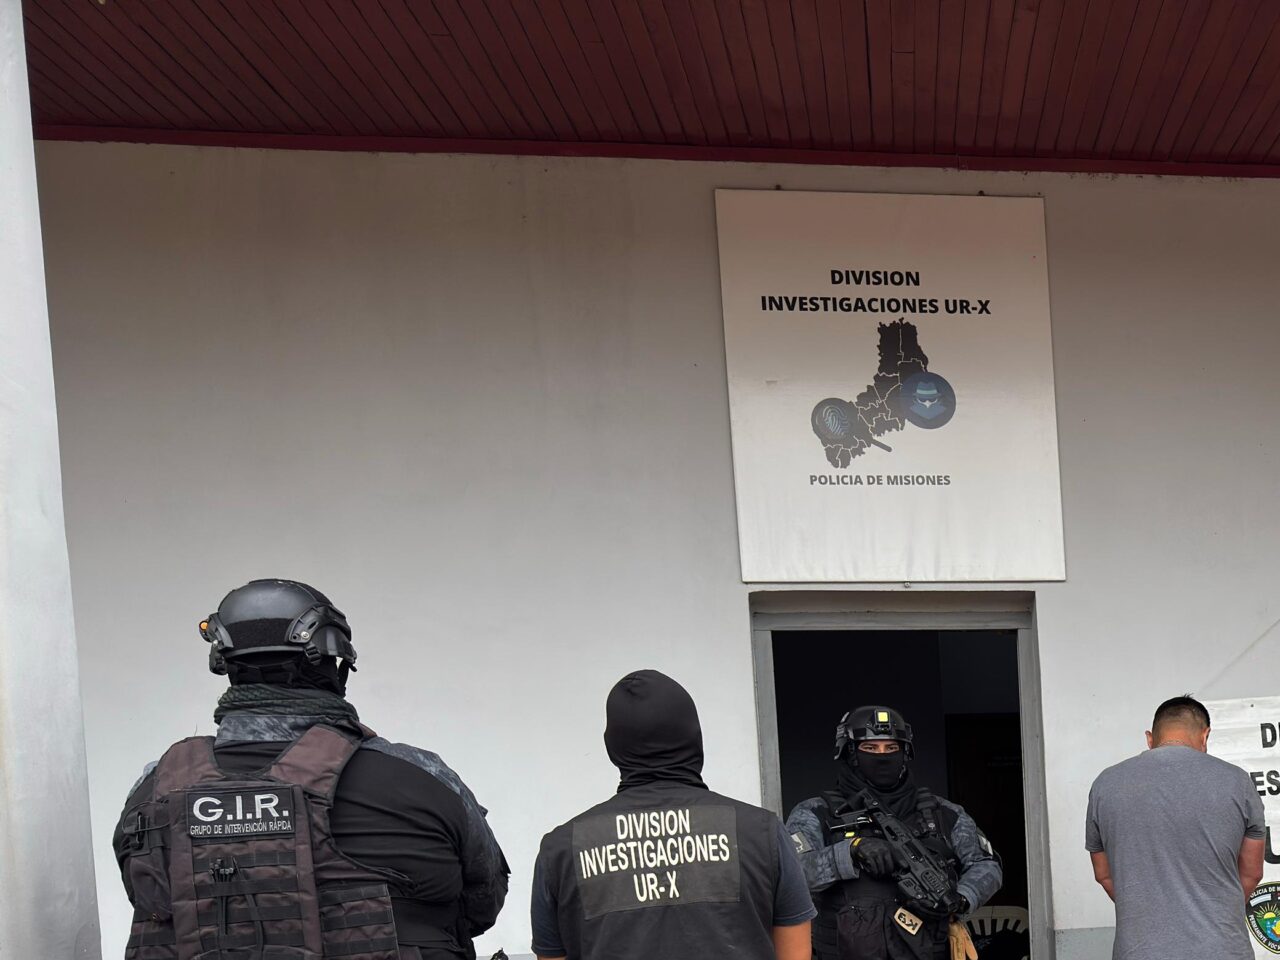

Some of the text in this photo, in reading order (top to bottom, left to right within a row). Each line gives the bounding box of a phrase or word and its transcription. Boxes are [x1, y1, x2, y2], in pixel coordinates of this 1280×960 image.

[830, 269, 920, 287] DIVISION
[761, 295, 991, 315] INVESTIGACIONES UR-X
[809, 474, 951, 486] POLICIA DE MISIONES
[192, 793, 290, 822] G.I.R.
[190, 825, 212, 835] GRUPO
[213, 824, 223, 835] DE
[615, 809, 691, 840] DIVISION
[579, 833, 731, 879] INVESTIGACIONES
